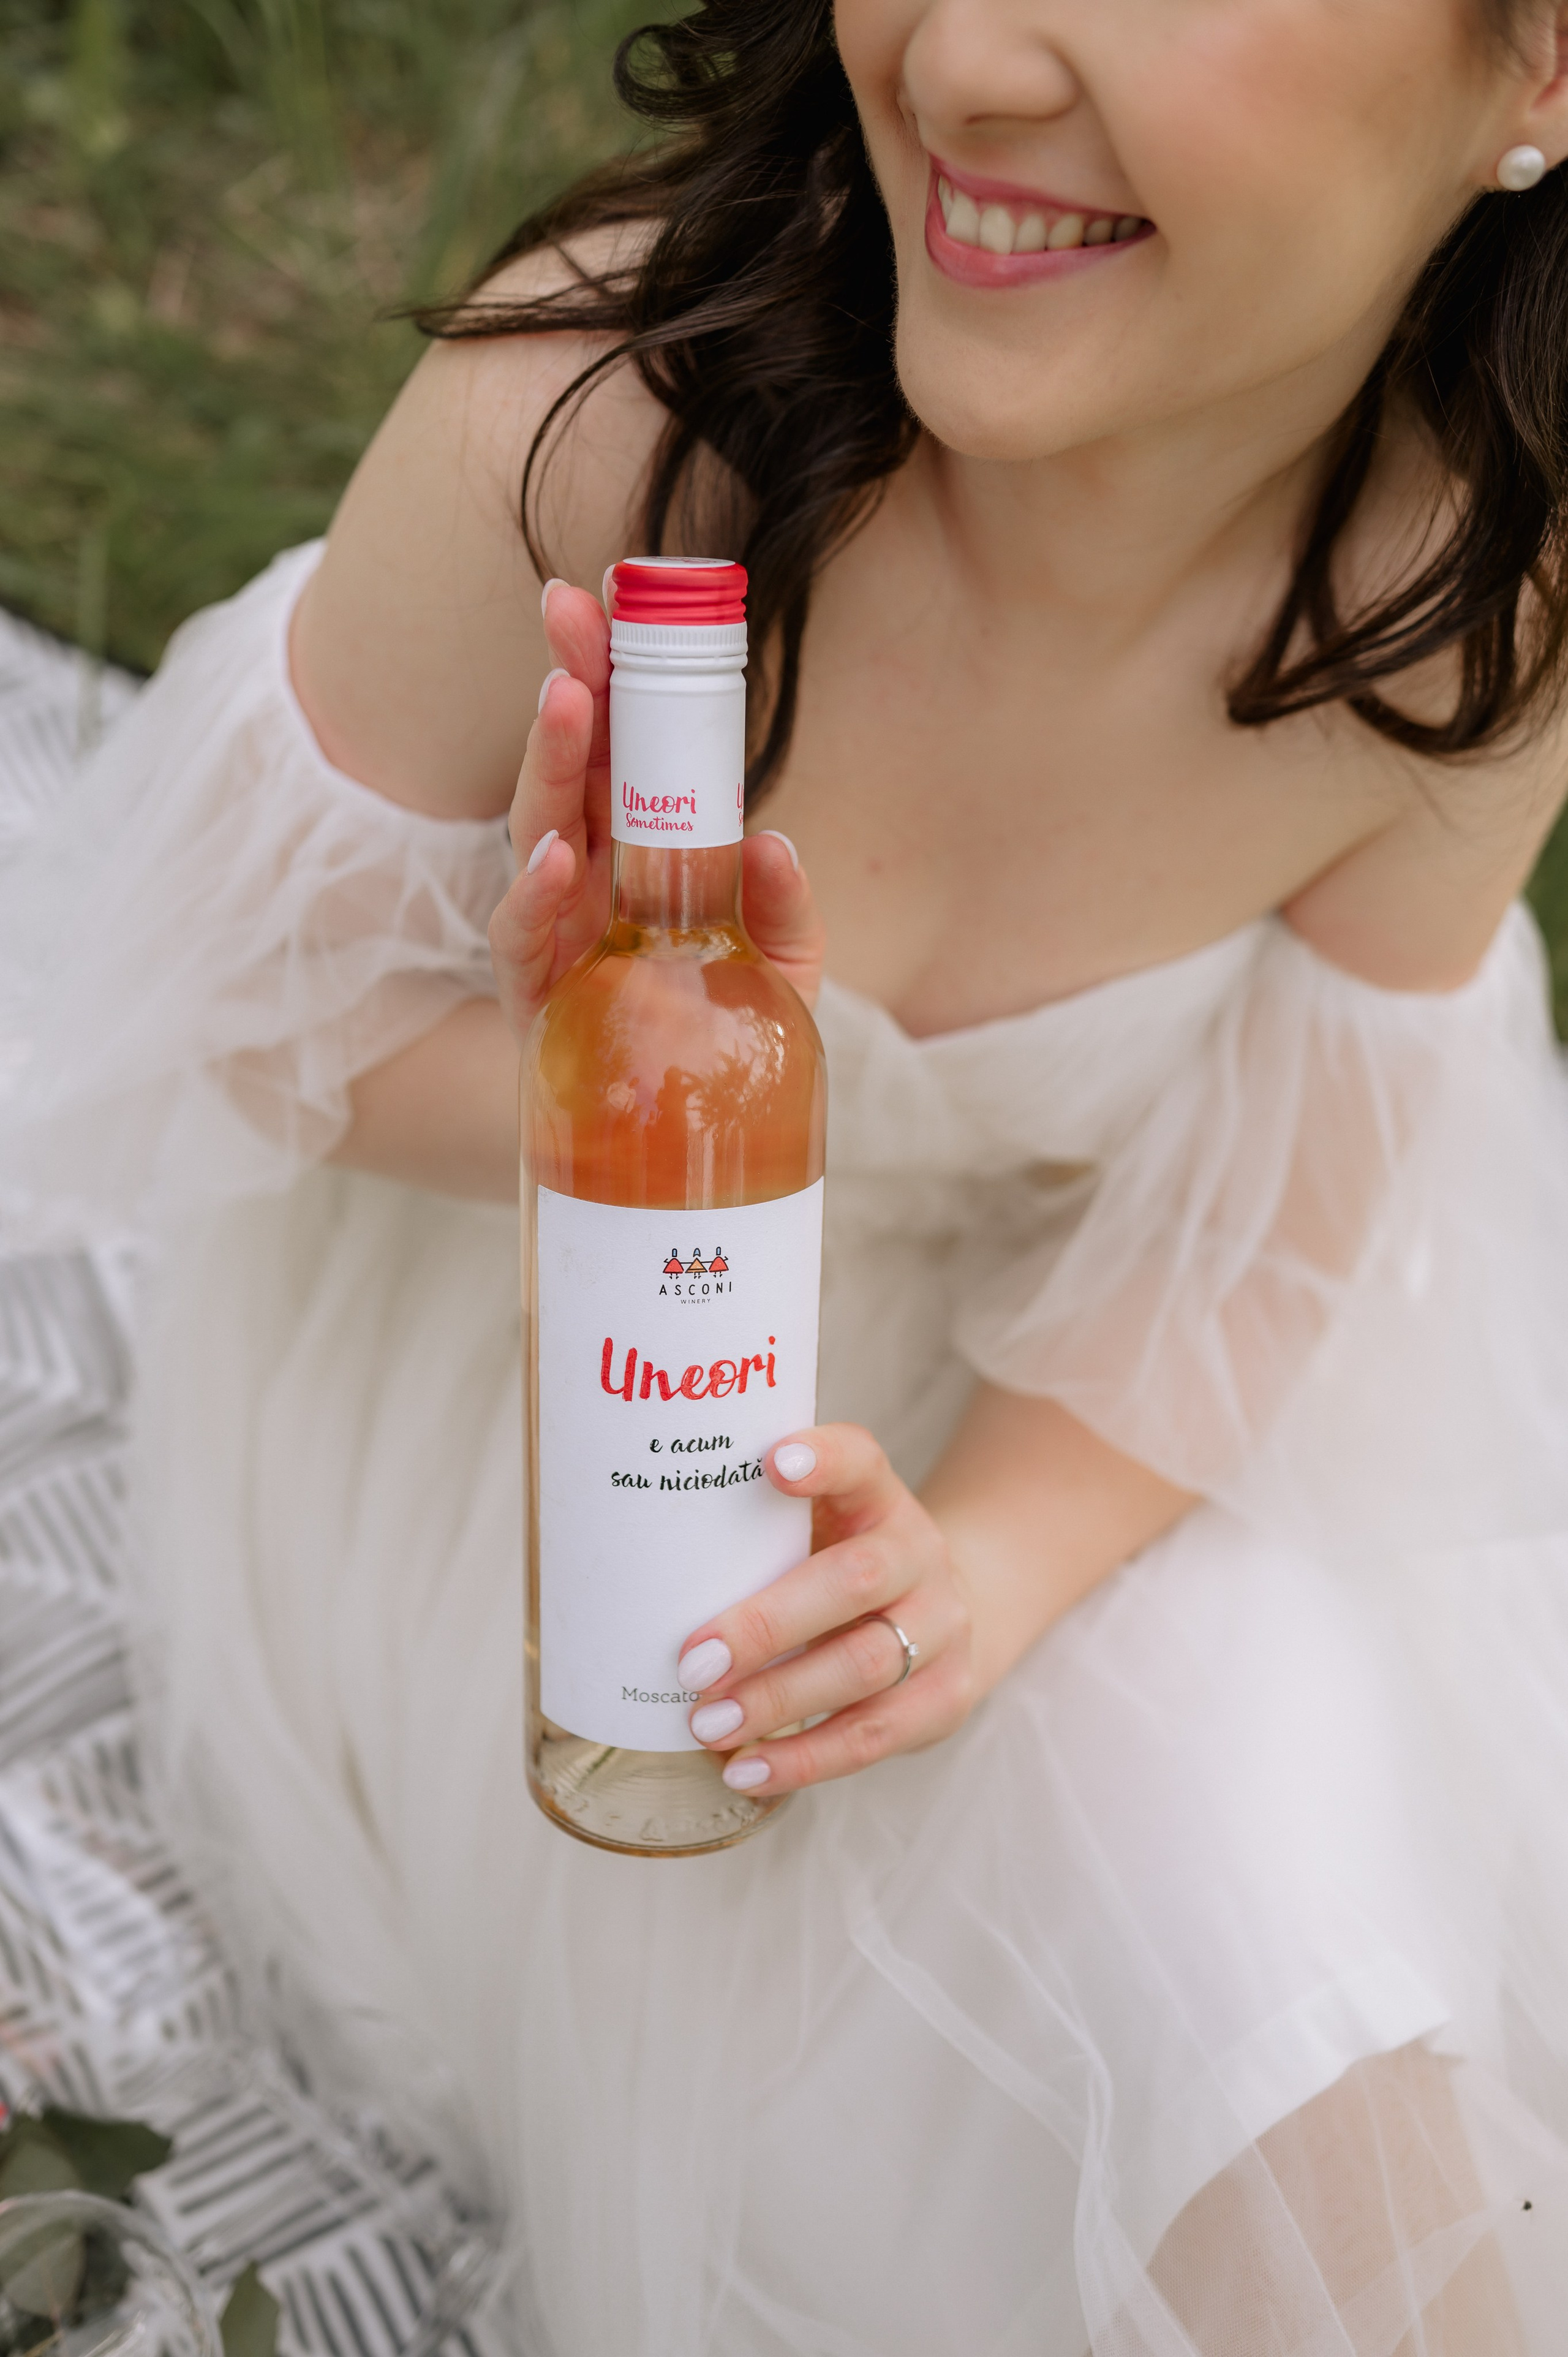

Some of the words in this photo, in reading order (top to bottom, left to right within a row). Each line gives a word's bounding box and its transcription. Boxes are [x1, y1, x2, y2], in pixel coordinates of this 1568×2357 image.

[623, 781, 696, 814] Uneori
[626, 812, 693, 831] Sometimes
[659, 1281, 731, 1296] ASCONI
[601, 1336, 776, 1402] Uneori
[649, 1439, 663, 1453] e
[671, 1435, 734, 1454] acum
[611, 1472, 652, 1489] sau
[660, 1458, 765, 1491] niciodată
[621, 1686, 701, 1703] Moscato
